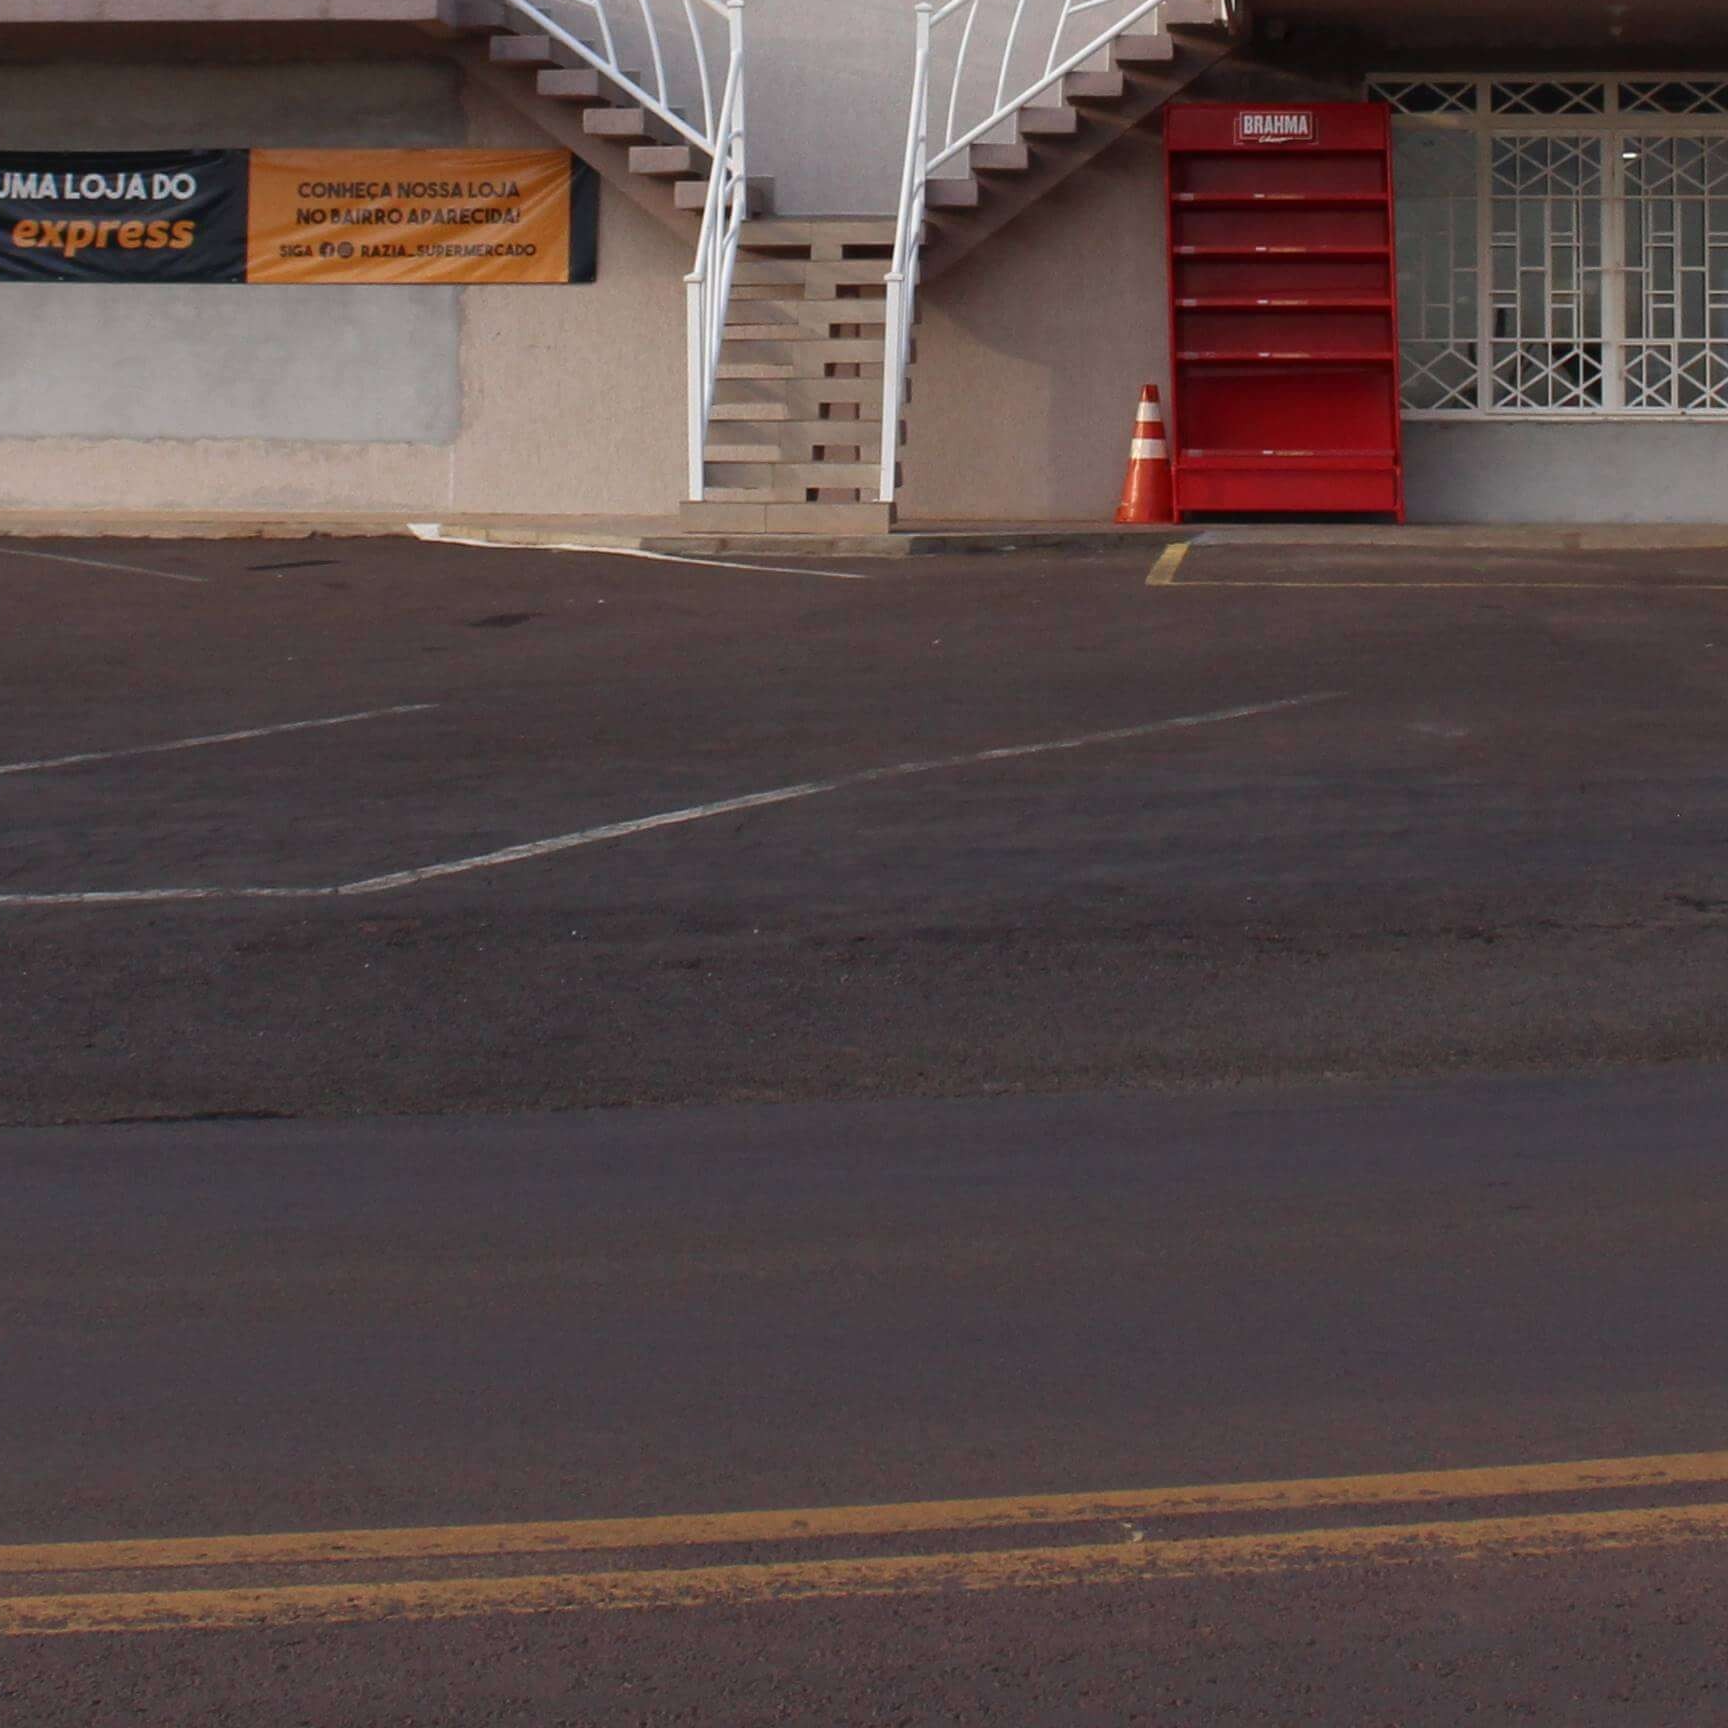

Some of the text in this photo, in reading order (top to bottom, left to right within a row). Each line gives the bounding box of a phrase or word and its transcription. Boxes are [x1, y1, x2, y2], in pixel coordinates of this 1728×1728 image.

[1243, 114, 1308, 135] BRAHMA
[65, 173, 151, 200] LOJA
[153, 173, 197, 200] DO
[297, 181, 521, 201] CONHEÇA NOSSA LOJA
[296, 207, 521, 224] NO BAIRRO APARECIDA!
[12, 217, 196, 259] express
[279, 244, 313, 258] SIGA
